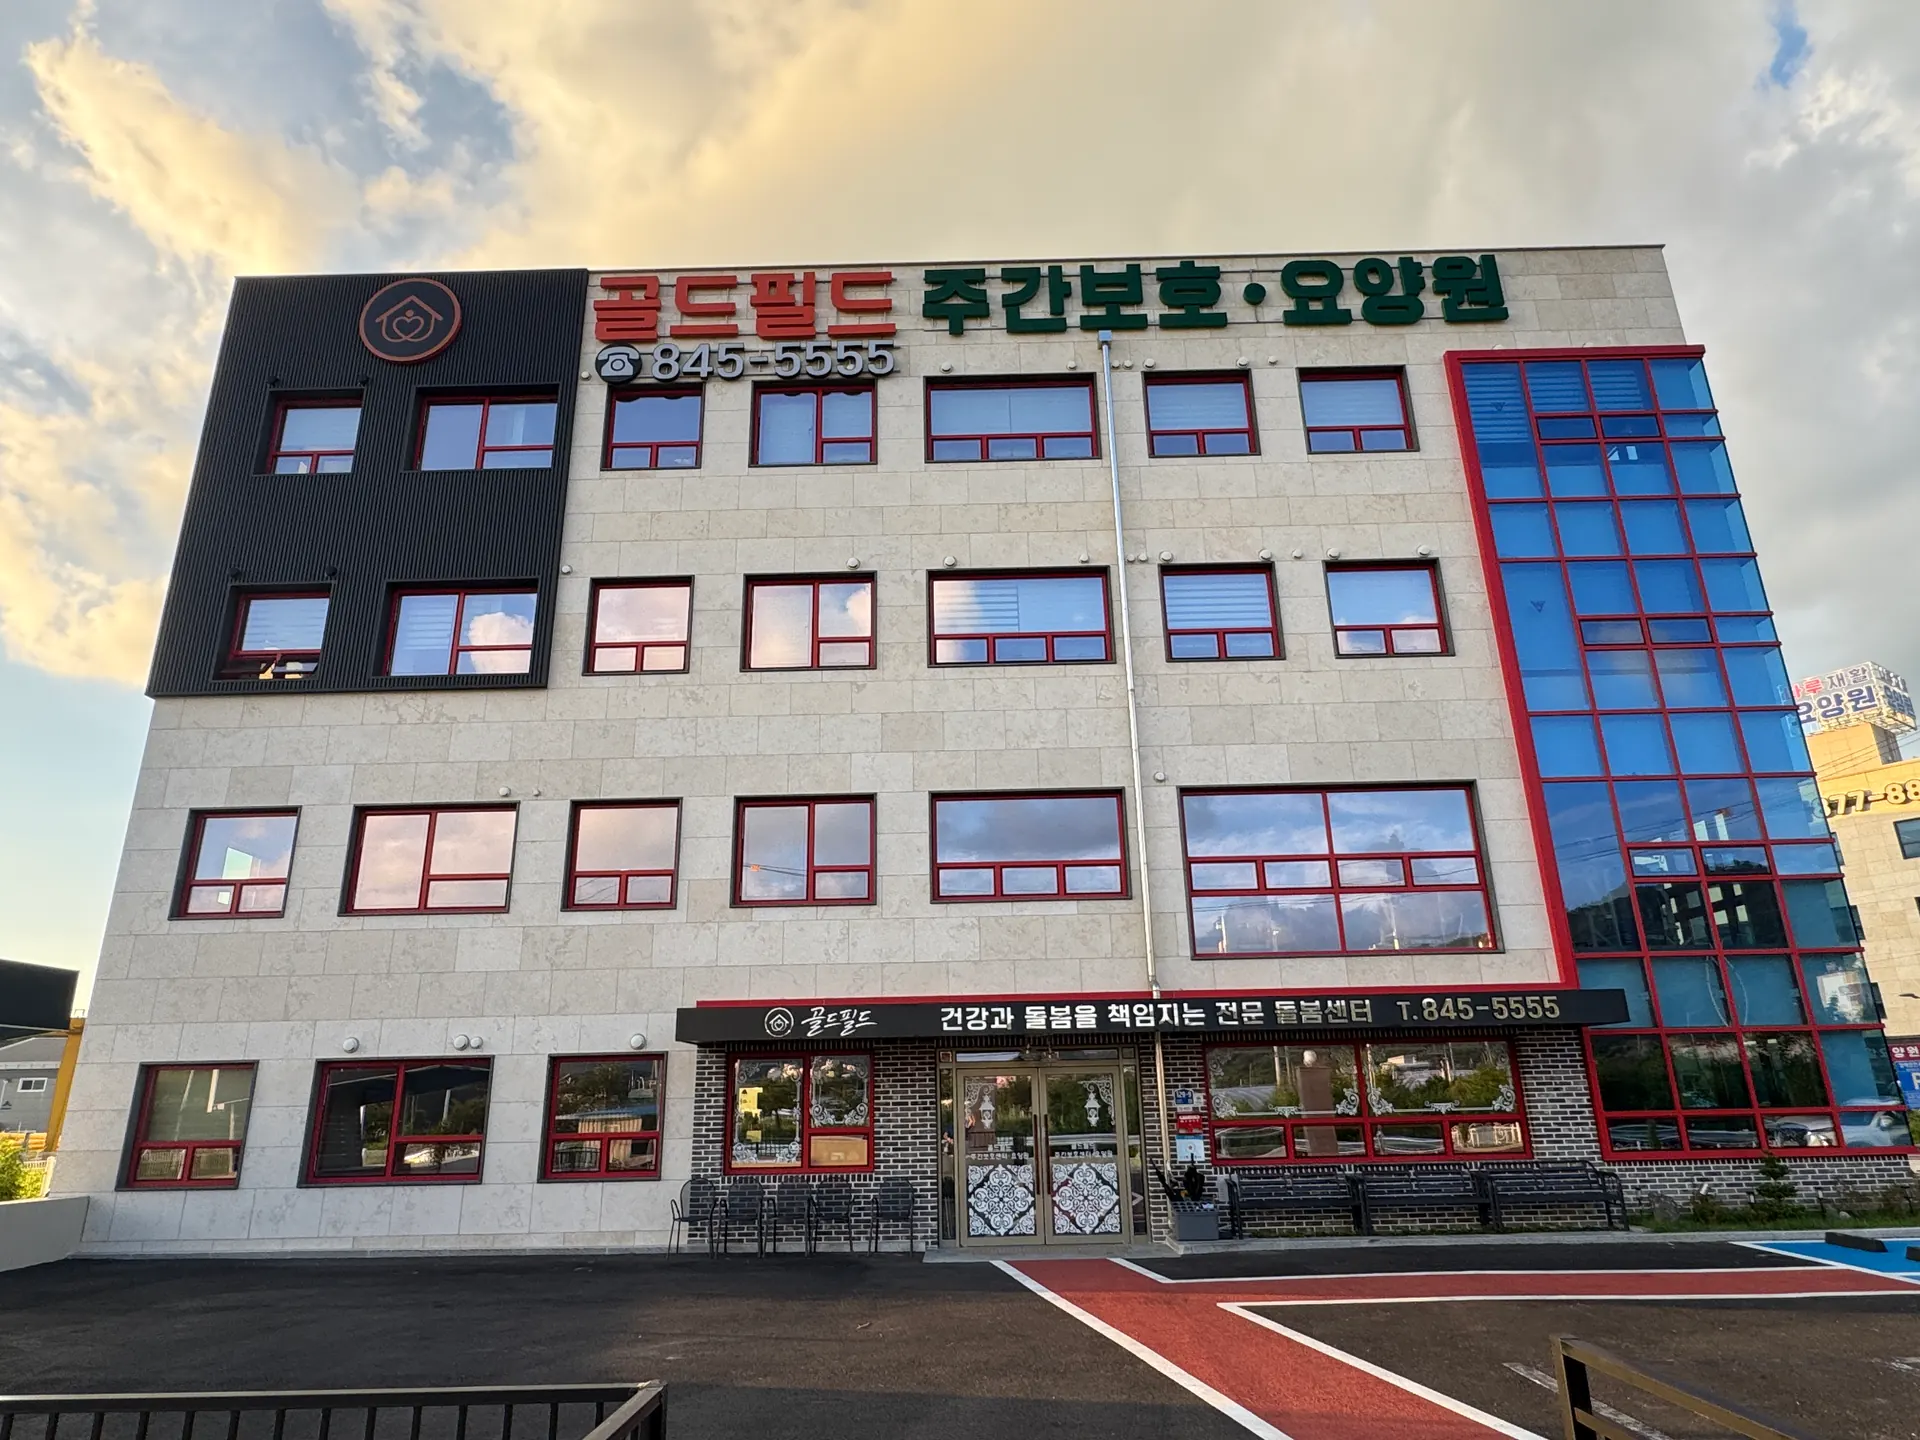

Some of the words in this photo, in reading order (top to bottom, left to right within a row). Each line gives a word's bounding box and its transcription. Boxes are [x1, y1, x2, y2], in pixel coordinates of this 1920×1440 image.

[593, 271, 897, 342] 골드필드
[651, 340, 896, 381] 845-5555
[801, 1006, 878, 1037] 골드필드
[940, 1006, 1015, 1031] 건강과
[1024, 1004, 1098, 1030] 돌봄을
[1107, 1002, 1206, 1028] 책임지는
[1215, 1001, 1265, 1026] 전문
[1274, 999, 1373, 1025] 돌봄센터
